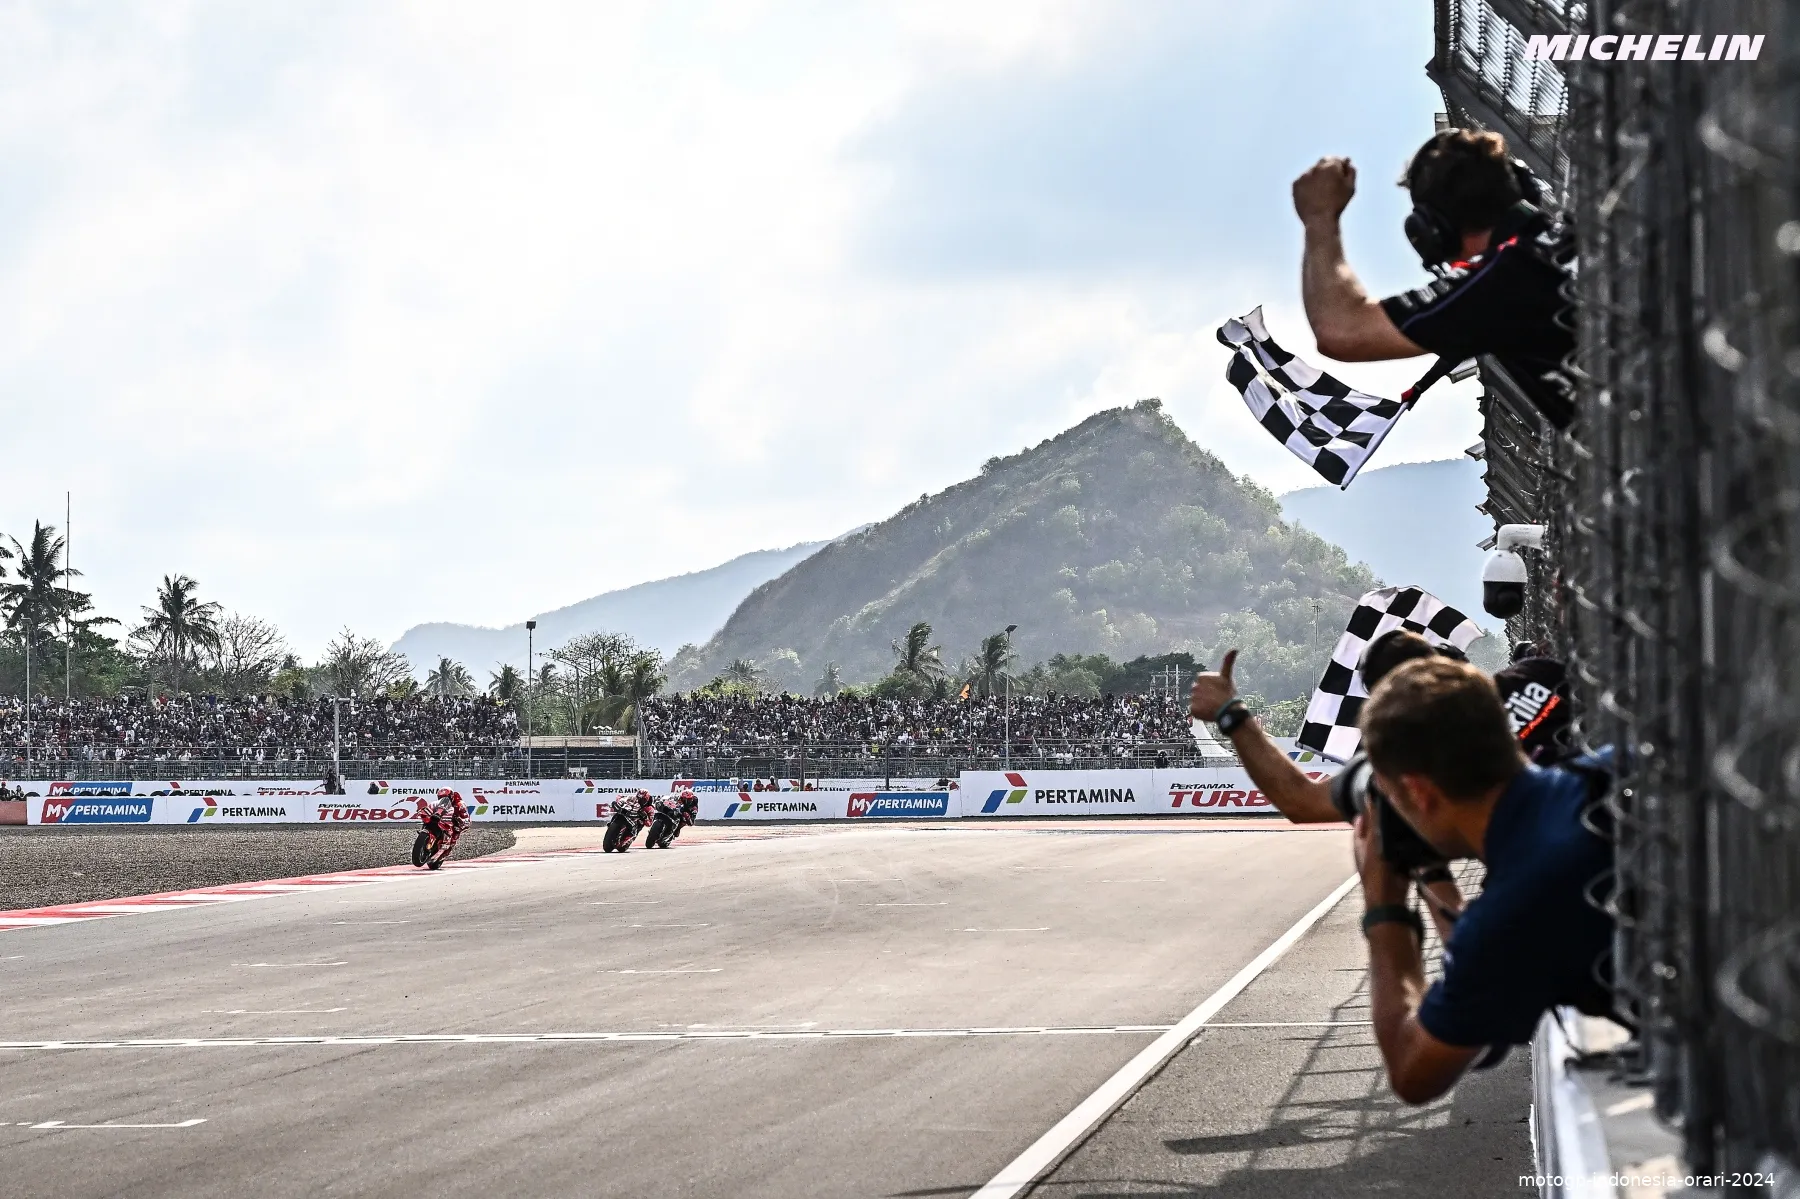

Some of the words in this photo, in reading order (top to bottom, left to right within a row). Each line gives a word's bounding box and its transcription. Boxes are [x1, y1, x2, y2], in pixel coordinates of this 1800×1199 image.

[1034, 789, 1136, 804] PERTAMINA
[1168, 790, 1273, 808] TURB
[222, 807, 287, 817] PERTAMINA
[492, 805, 556, 815] PERTAMINA
[756, 803, 818, 812] PERTAMINA
[317, 809, 410, 821] TURBO
